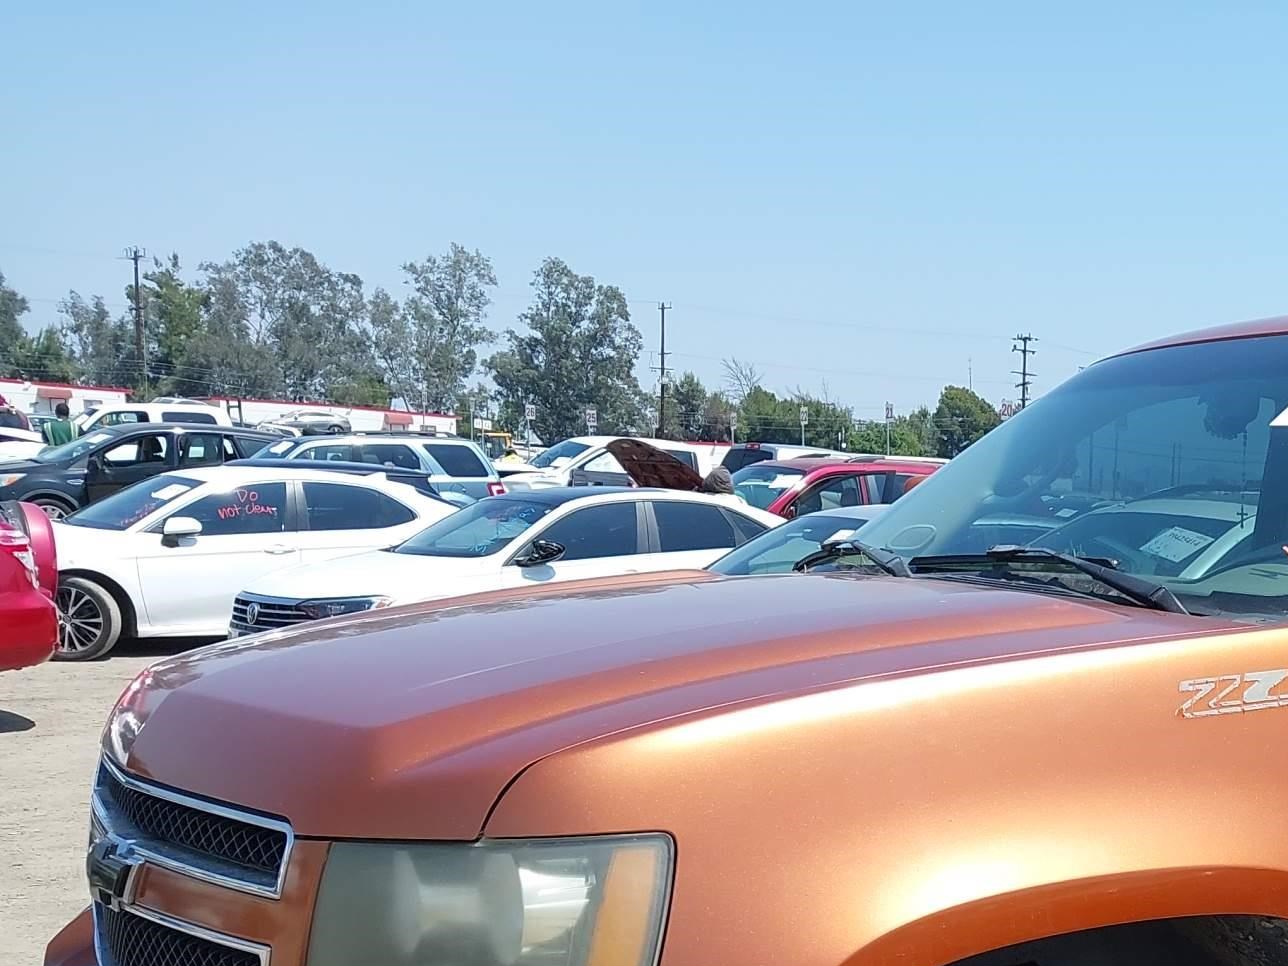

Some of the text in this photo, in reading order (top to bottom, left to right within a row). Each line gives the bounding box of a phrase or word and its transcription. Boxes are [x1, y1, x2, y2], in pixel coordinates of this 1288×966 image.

[526, 406, 535, 417] 26
[885, 407, 894, 419] 21
[1001, 403, 1013, 416] 20
[586, 412, 597, 423] 25
